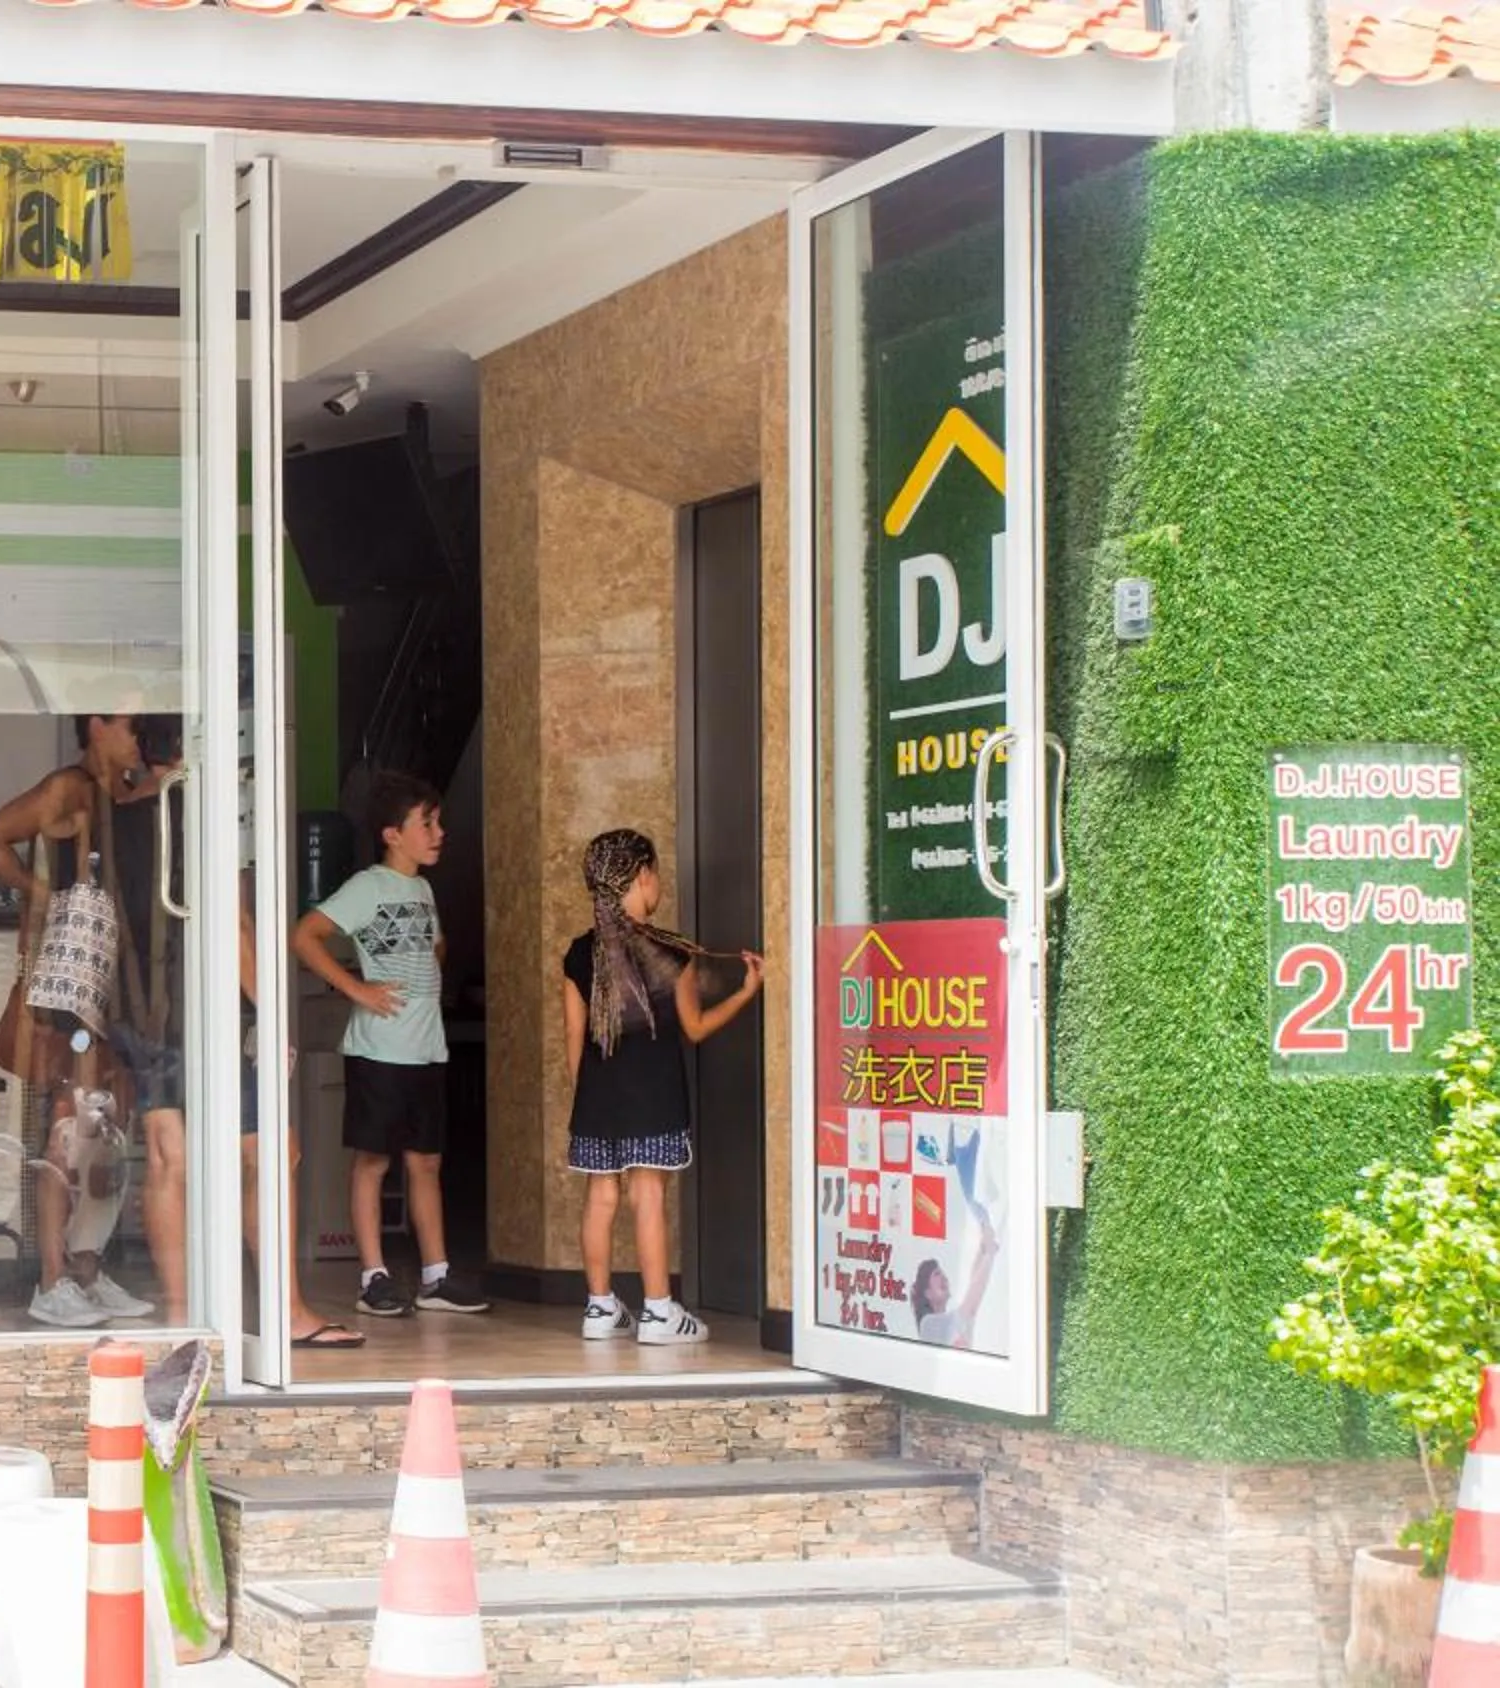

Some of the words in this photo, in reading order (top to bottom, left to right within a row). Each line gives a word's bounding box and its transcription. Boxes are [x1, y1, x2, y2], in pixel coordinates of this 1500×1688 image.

[900, 532, 1006, 682] DJ
[1278, 816, 1462, 869] Laundry
[839, 976, 872, 1029] DJ
[877, 976, 988, 1028] HOUSE
[841, 1044, 988, 1109] 洗衣店
[318, 1233, 357, 1248] SANY
[836, 1231, 892, 1268] Laundry
